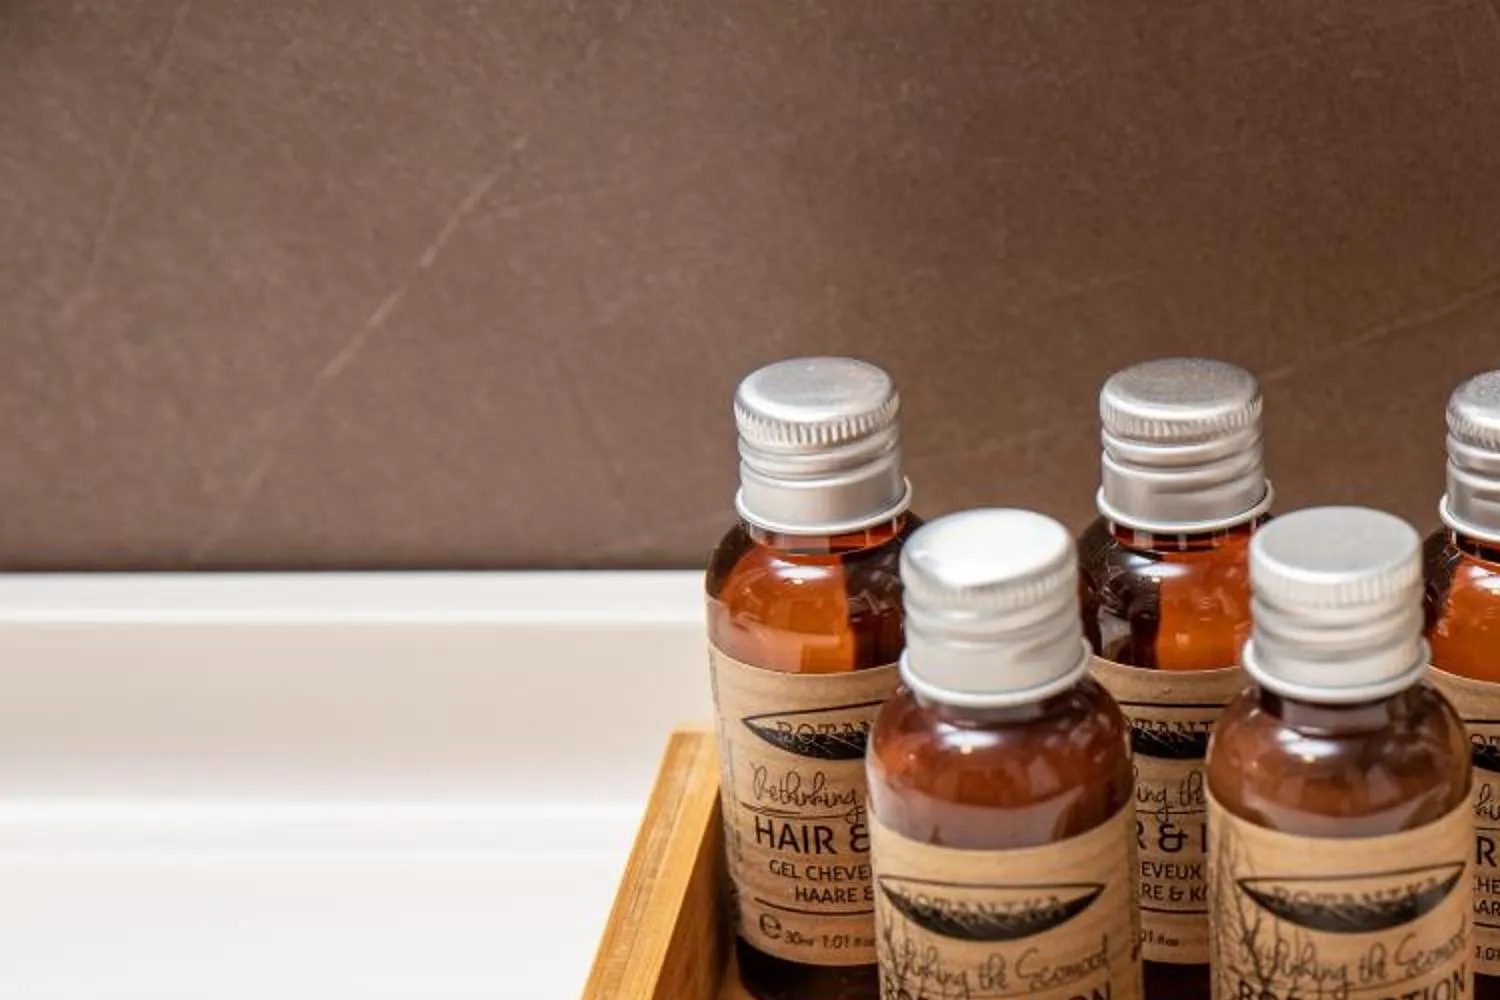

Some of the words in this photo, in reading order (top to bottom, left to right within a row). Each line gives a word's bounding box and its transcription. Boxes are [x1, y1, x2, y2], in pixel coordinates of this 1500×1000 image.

[755, 815, 838, 855] HAIR
[769, 858, 803, 880] GEL
[805, 863, 873, 882] CHEVE
[1141, 861, 1202, 880] EVEUX
[795, 885, 858, 904] HAARE
